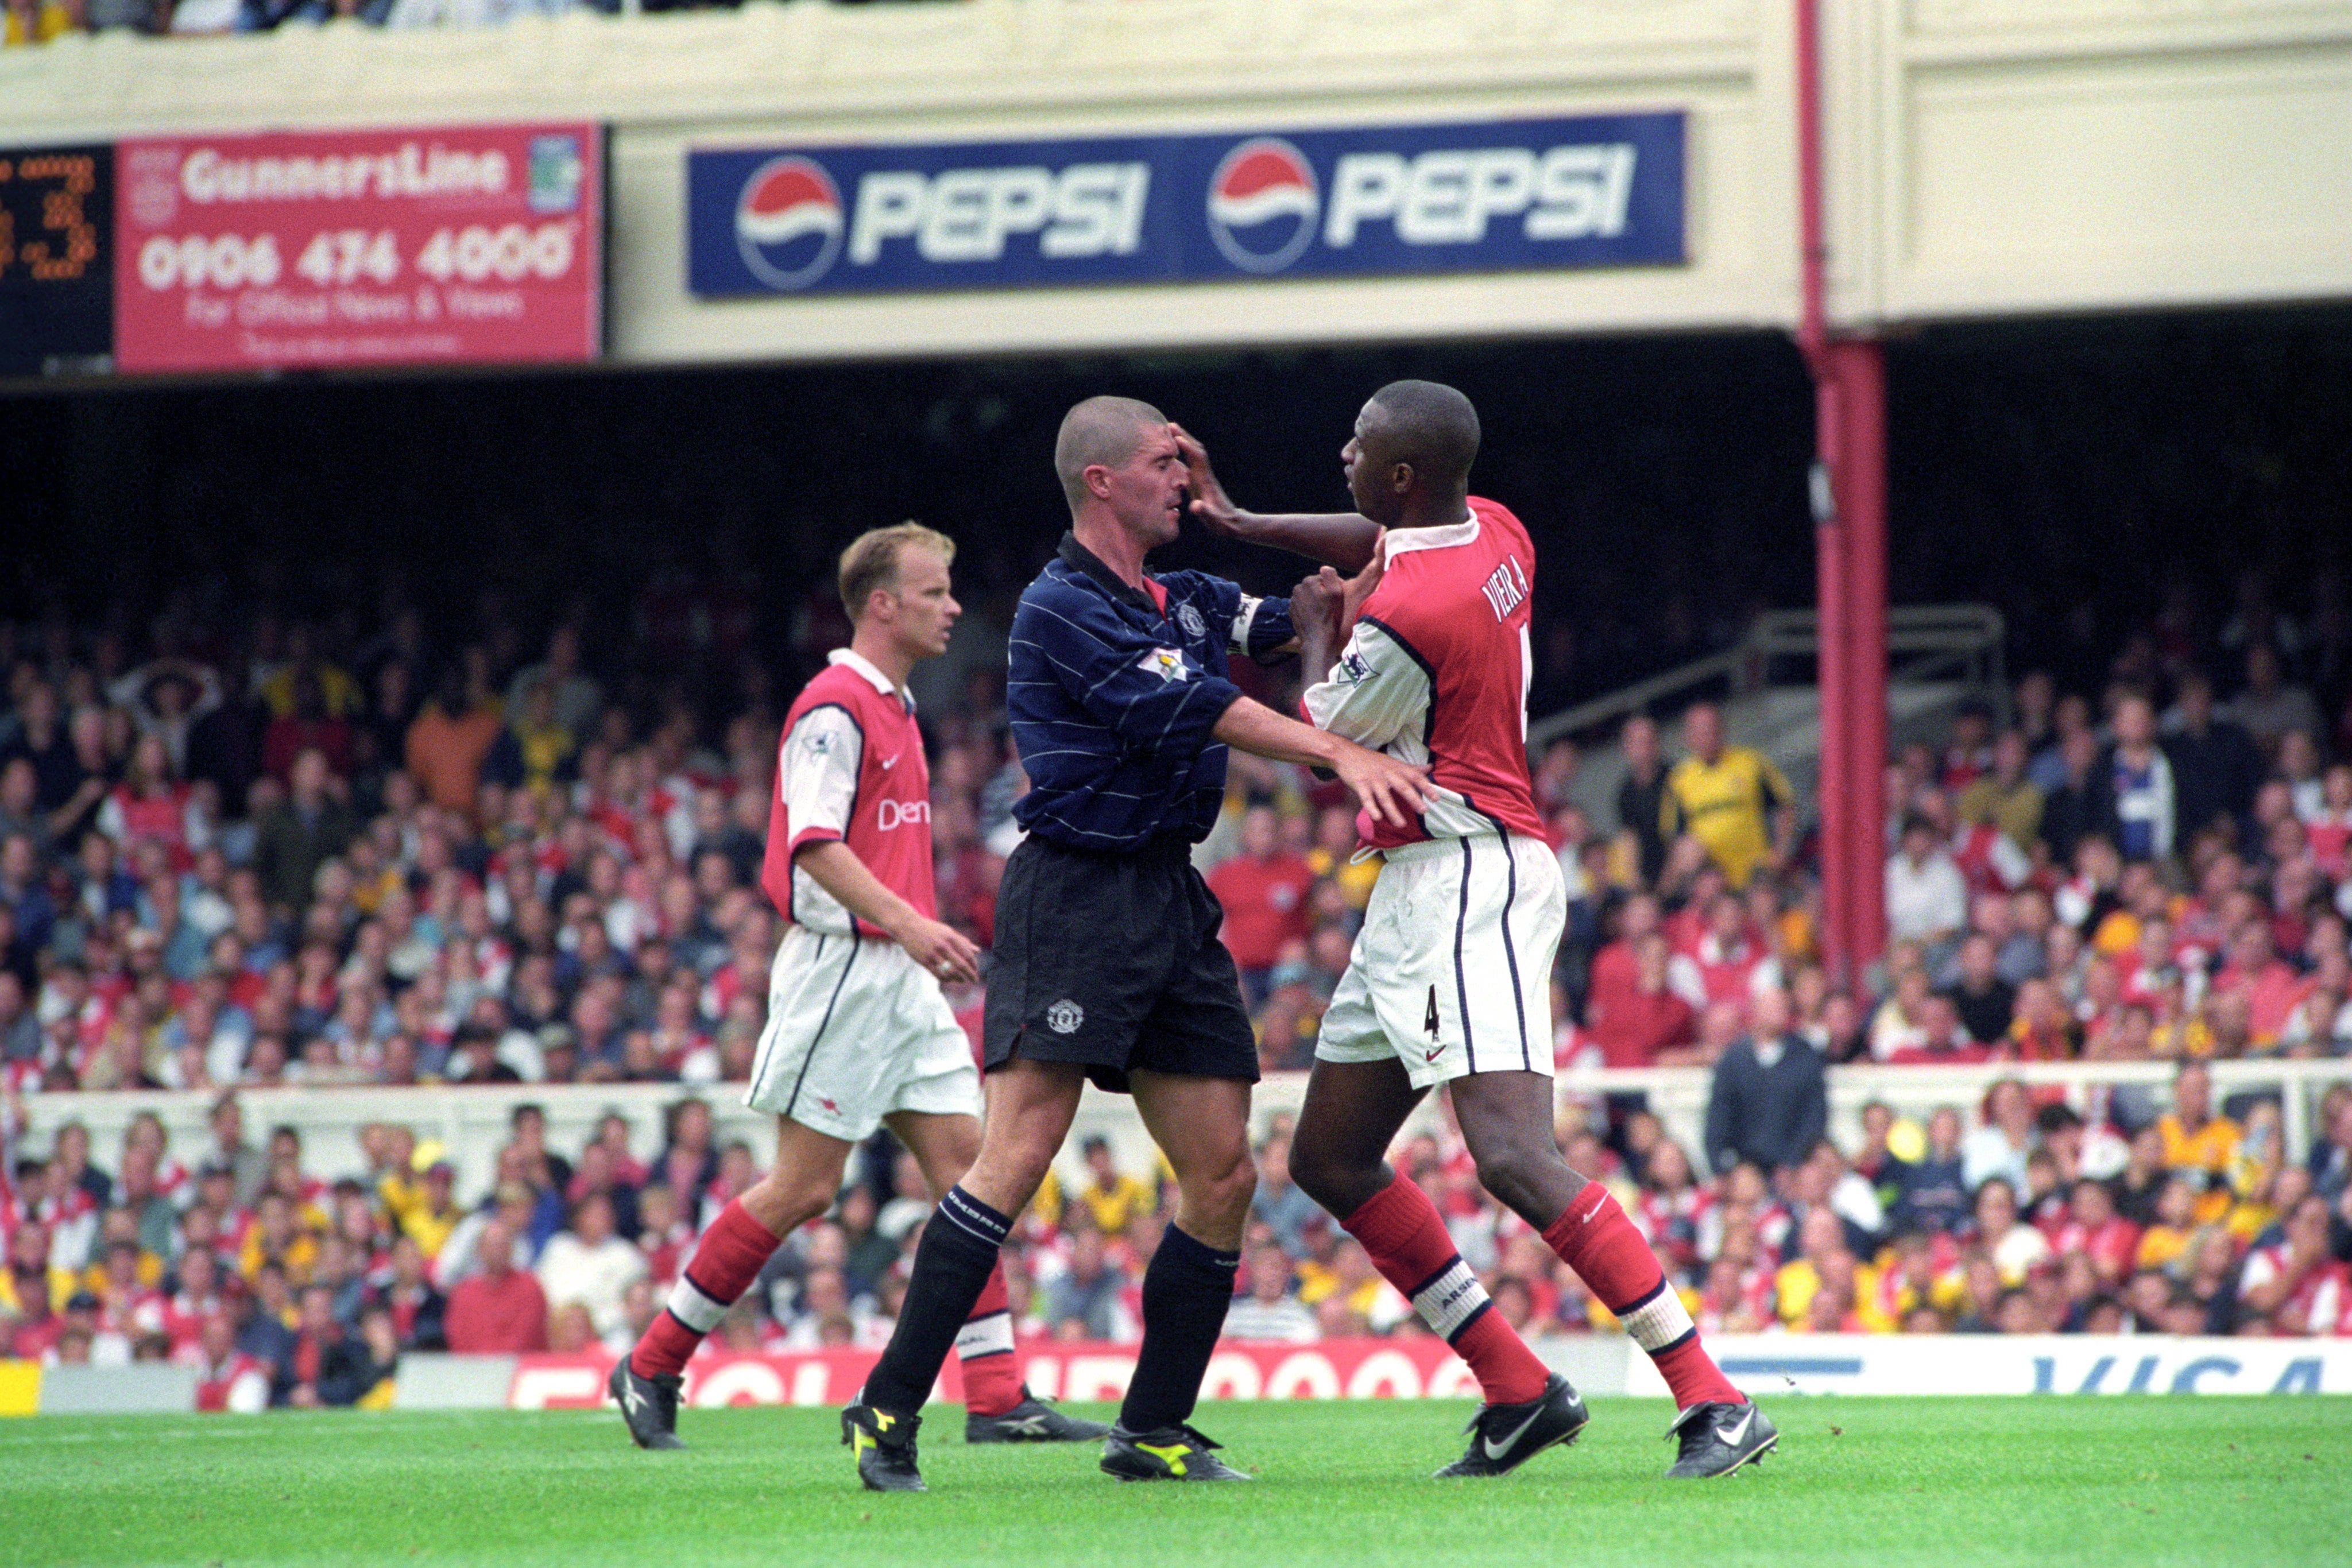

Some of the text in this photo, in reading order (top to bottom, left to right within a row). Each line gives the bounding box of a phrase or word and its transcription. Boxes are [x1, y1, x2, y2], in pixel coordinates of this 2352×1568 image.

[0, 154, 96, 281] 3
[849, 161, 1147, 265] PEPSI
[1326, 142, 1637, 249] PEPSI
[139, 222, 572, 291] 0906 474 4000
[1423, 984, 1440, 1042] 4
